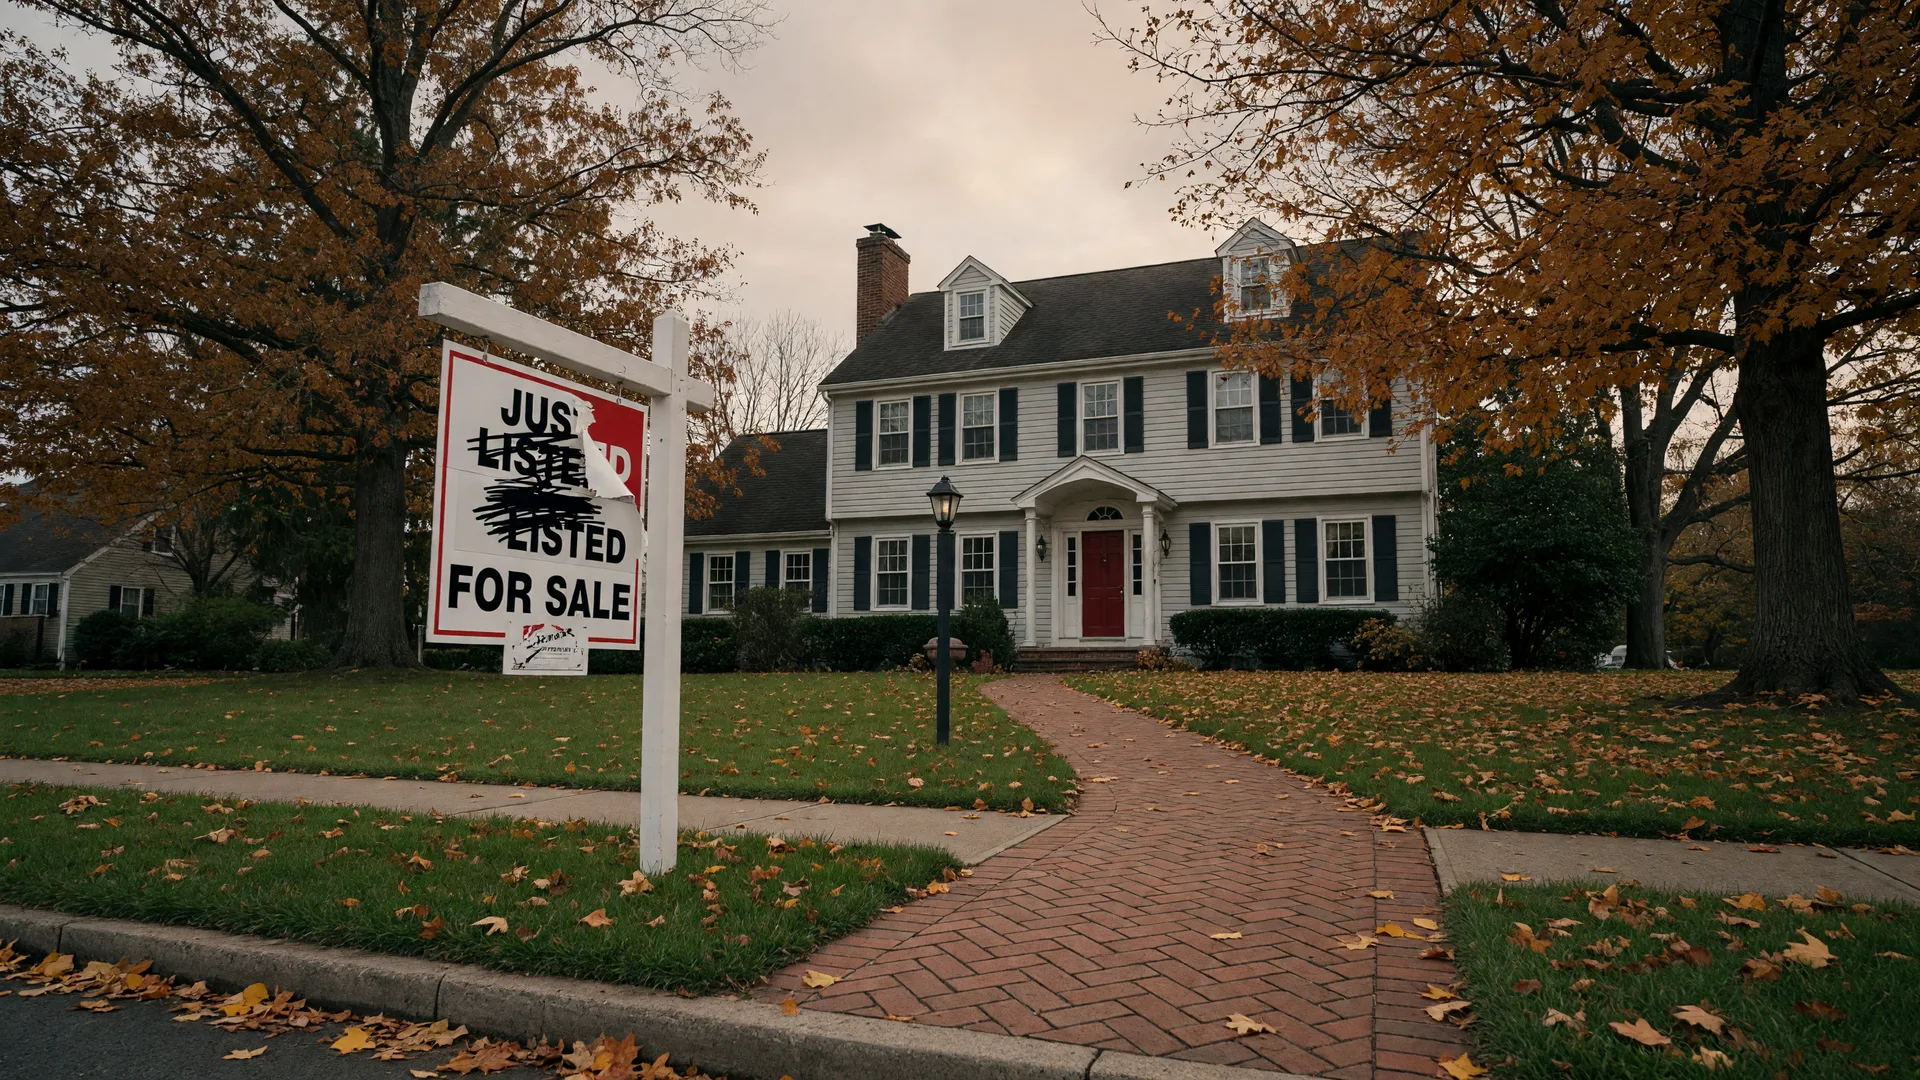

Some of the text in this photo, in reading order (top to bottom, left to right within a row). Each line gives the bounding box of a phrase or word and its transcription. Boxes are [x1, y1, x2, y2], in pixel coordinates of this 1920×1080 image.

[501, 388, 579, 436] JUS
[477, 426, 588, 489] LISTE
[448, 563, 631, 620] FOR SALE
